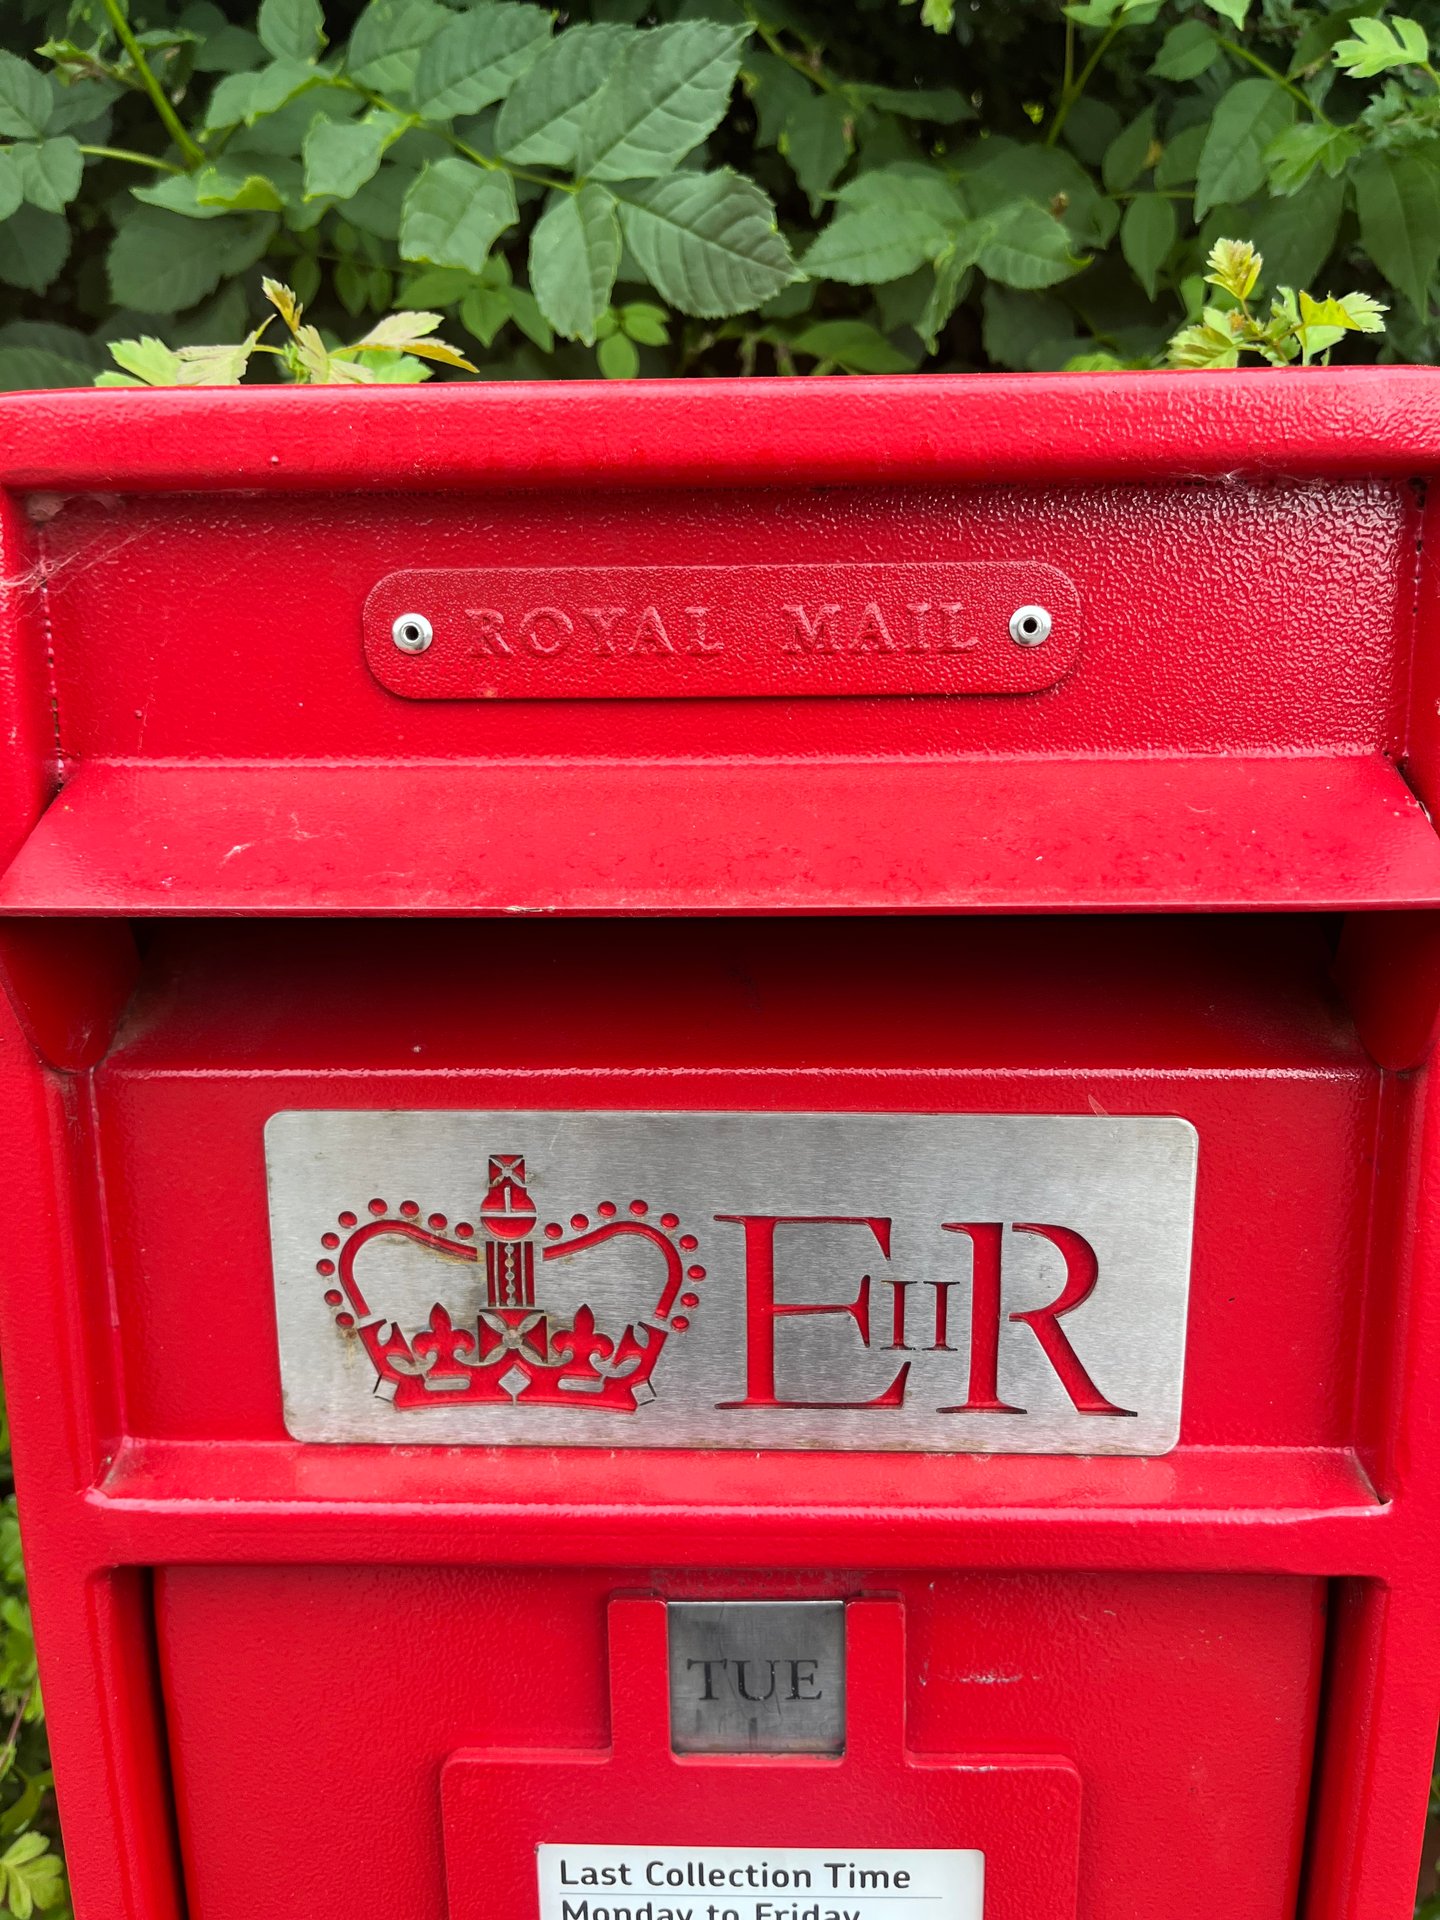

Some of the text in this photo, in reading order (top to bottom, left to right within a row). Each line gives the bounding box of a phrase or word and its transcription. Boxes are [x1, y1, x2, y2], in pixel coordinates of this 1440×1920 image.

[464, 599, 980, 658] ROYAL MAIL
[687, 1658, 823, 1701] TUE
[559, 1859, 912, 1890] Last Collection Time
[706, 1903, 740, 1920] to
